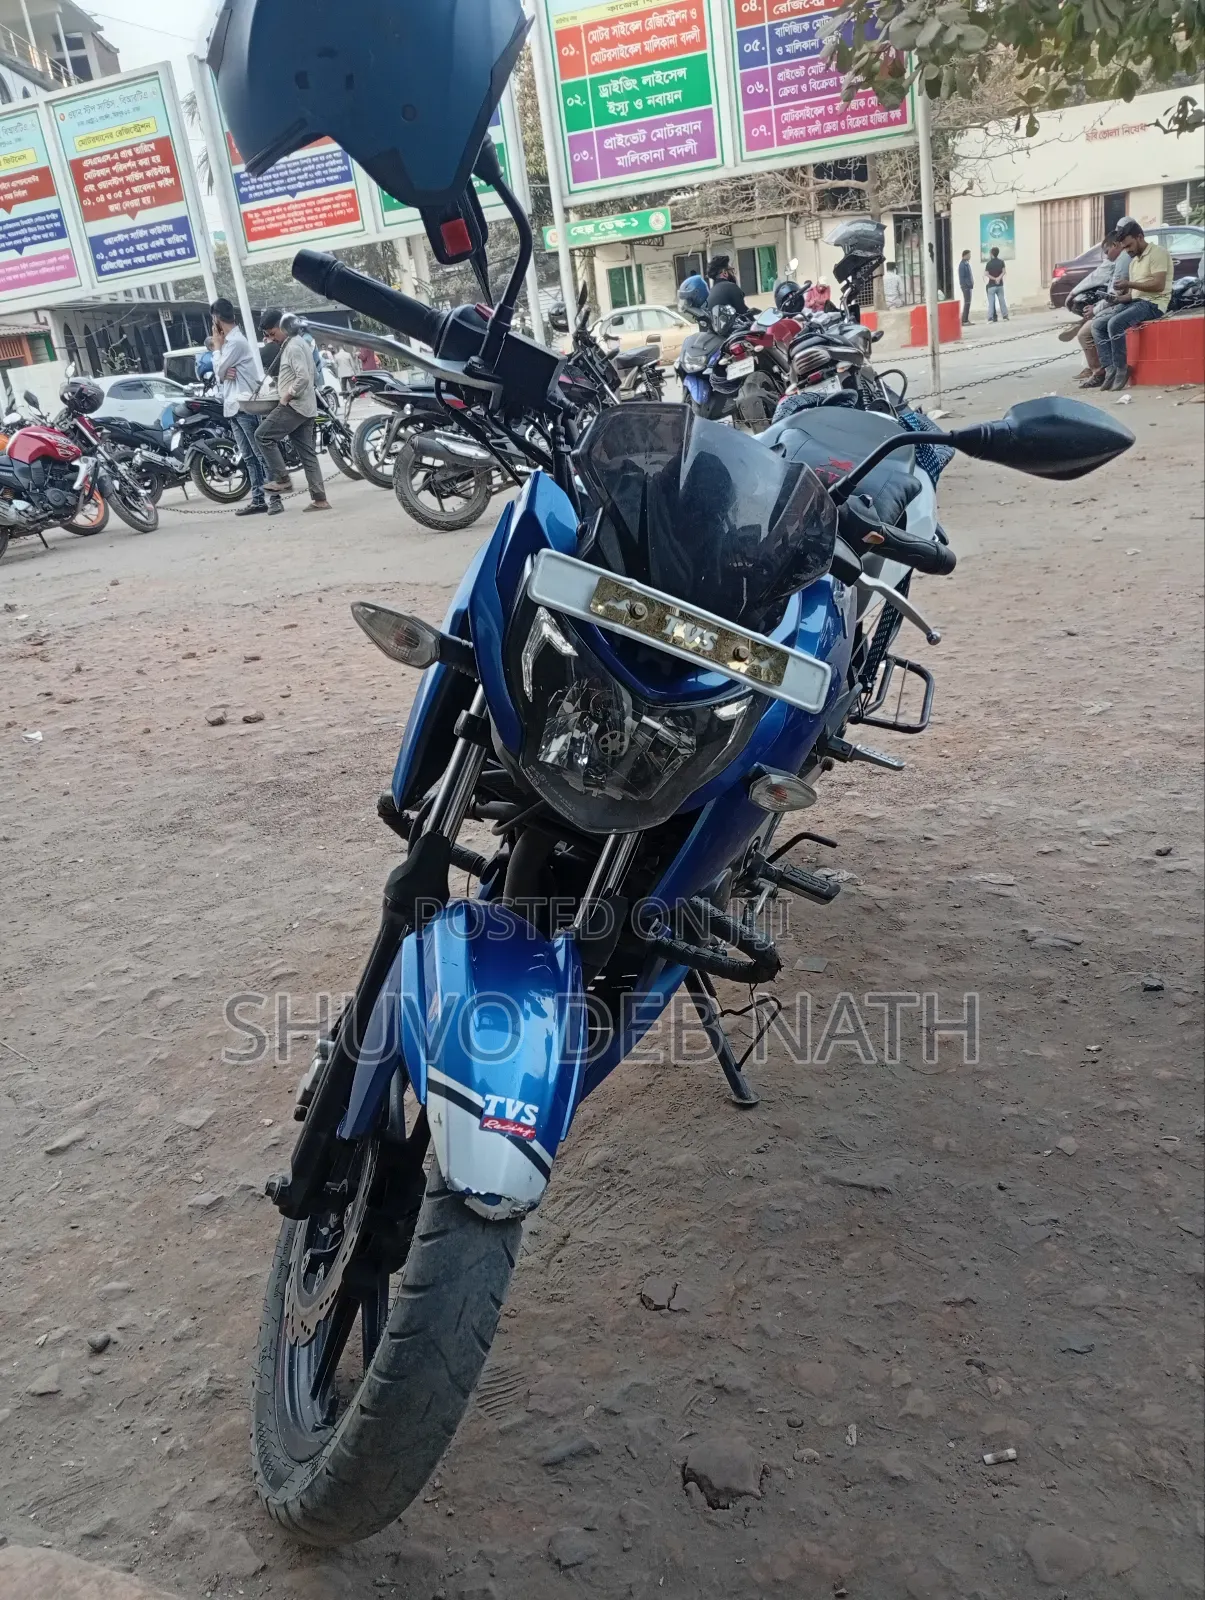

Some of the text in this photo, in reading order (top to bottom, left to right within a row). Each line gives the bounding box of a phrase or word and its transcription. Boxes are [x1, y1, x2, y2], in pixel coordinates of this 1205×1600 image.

[588, 8, 697, 44] মোটর সাইকেল রেজিস্ট্রেশন ও
[590, 25, 700, 65] মোটরসাইকেল মালিকানা বদলী
[776, 46, 784, 56] ও
[784, 38, 820, 54] মালিকানা
[598, 66, 687, 98] ড্রাইভিং লাইসেন্স
[776, 64, 806, 82] প্রাইভেট
[778, 84, 798, 98] ক্রেতা
[800, 84, 807, 92] ও
[808, 78, 837, 92] বিক্রেতা
[606, 89, 683, 116] ইস্যু ও নবায়ন
[827, 105, 834, 114] ও
[603, 120, 702, 150] প্রাইভেট মোটরযান
[1098, 128, 1120, 140] তোলা
[1122, 124, 1148, 136] নিষেধ
[616, 138, 698, 168] মালিকানা বদলী
[662, 614, 719, 651] TVS
[484, 1094, 539, 1126] TVS
[483, 1119, 536, 1137] Racing
